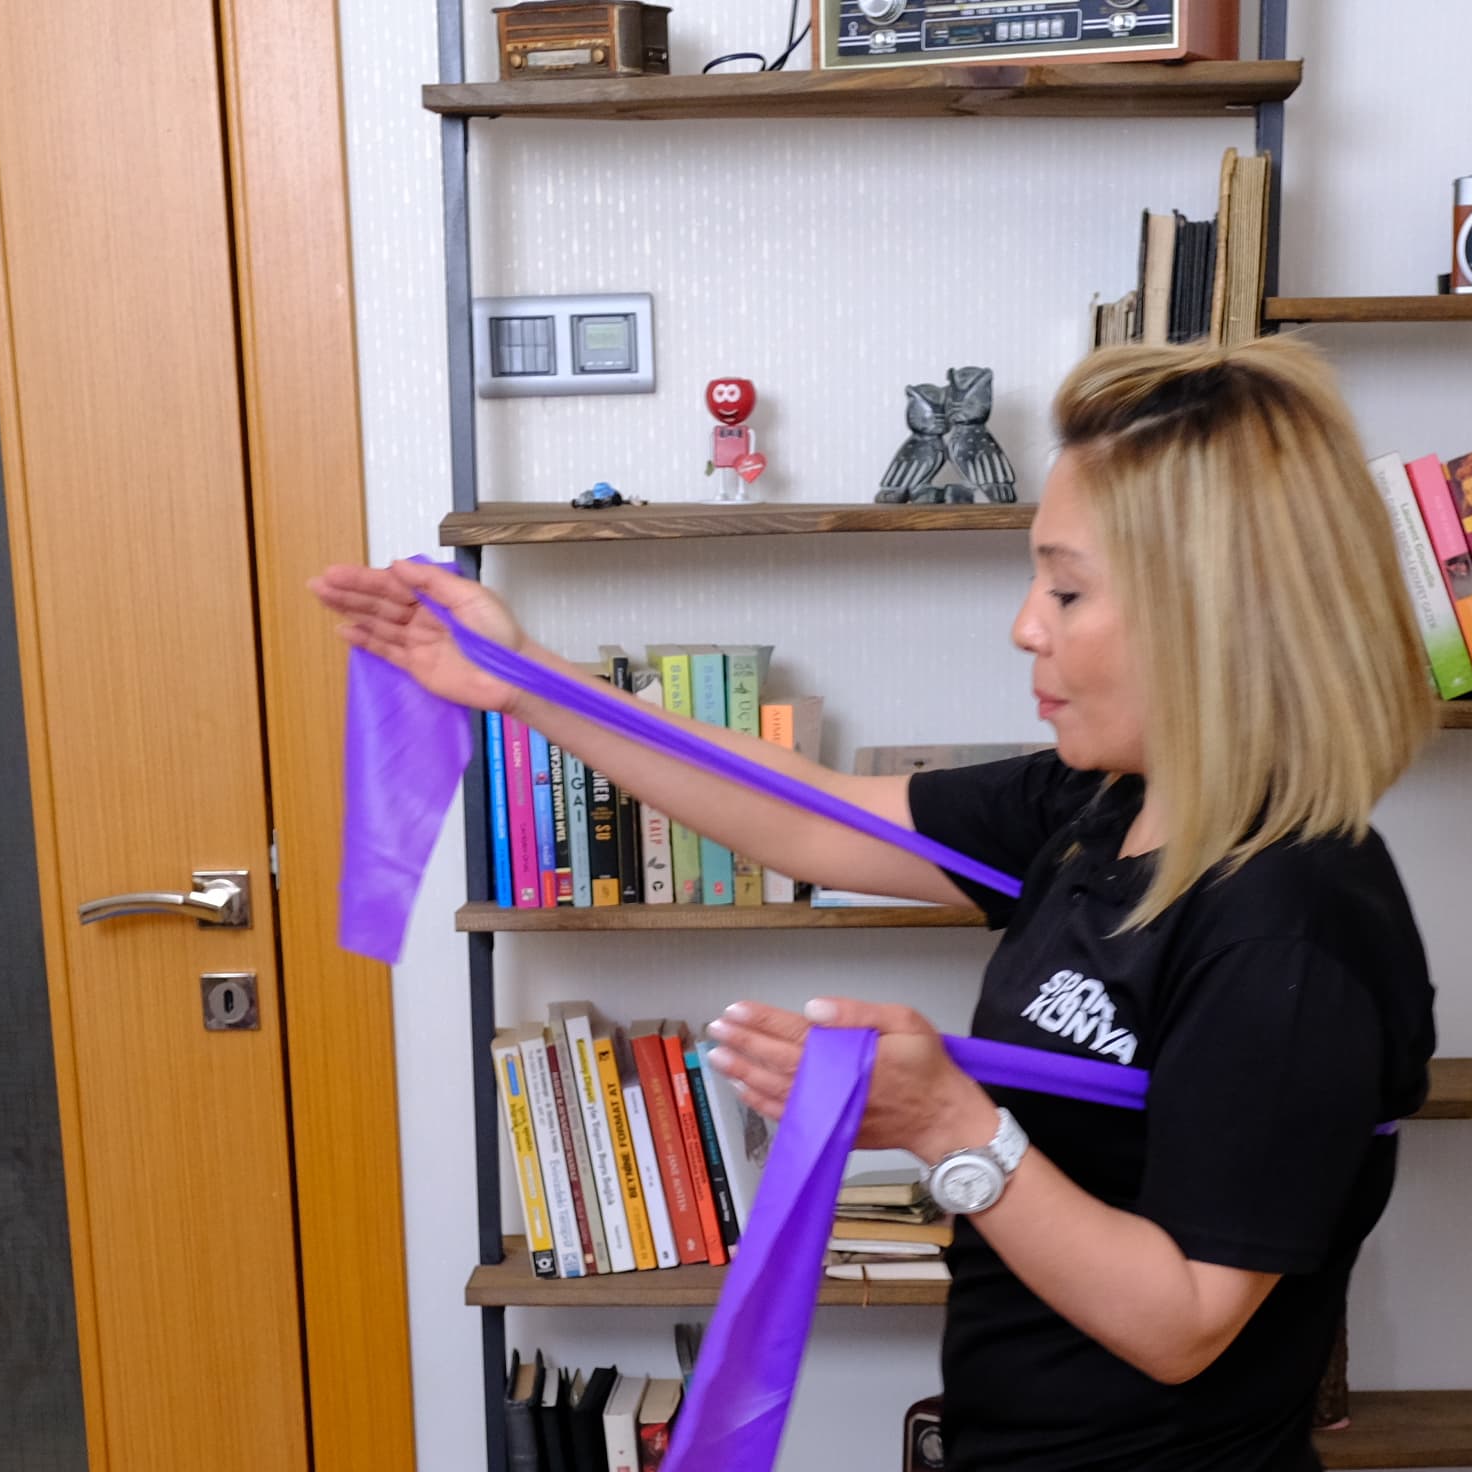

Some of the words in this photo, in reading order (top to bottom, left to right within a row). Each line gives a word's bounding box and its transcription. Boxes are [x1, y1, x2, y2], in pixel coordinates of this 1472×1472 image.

[670, 664, 683, 709] Sarah
[703, 664, 717, 709] Sarah
[553, 783, 564, 820] NAMAZ
[592, 770, 608, 802] UNER
[555, 821, 565, 842] TAM
[596, 824, 610, 841] SU
[649, 818, 661, 845] KALP
[1040, 970, 1117, 1022] SPOR
[1020, 992, 1138, 1065] KONYA
[606, 1081, 617, 1097] AT
[608, 1098, 627, 1148] FORMAT
[618, 1151, 638, 1199] BEYNİNE
